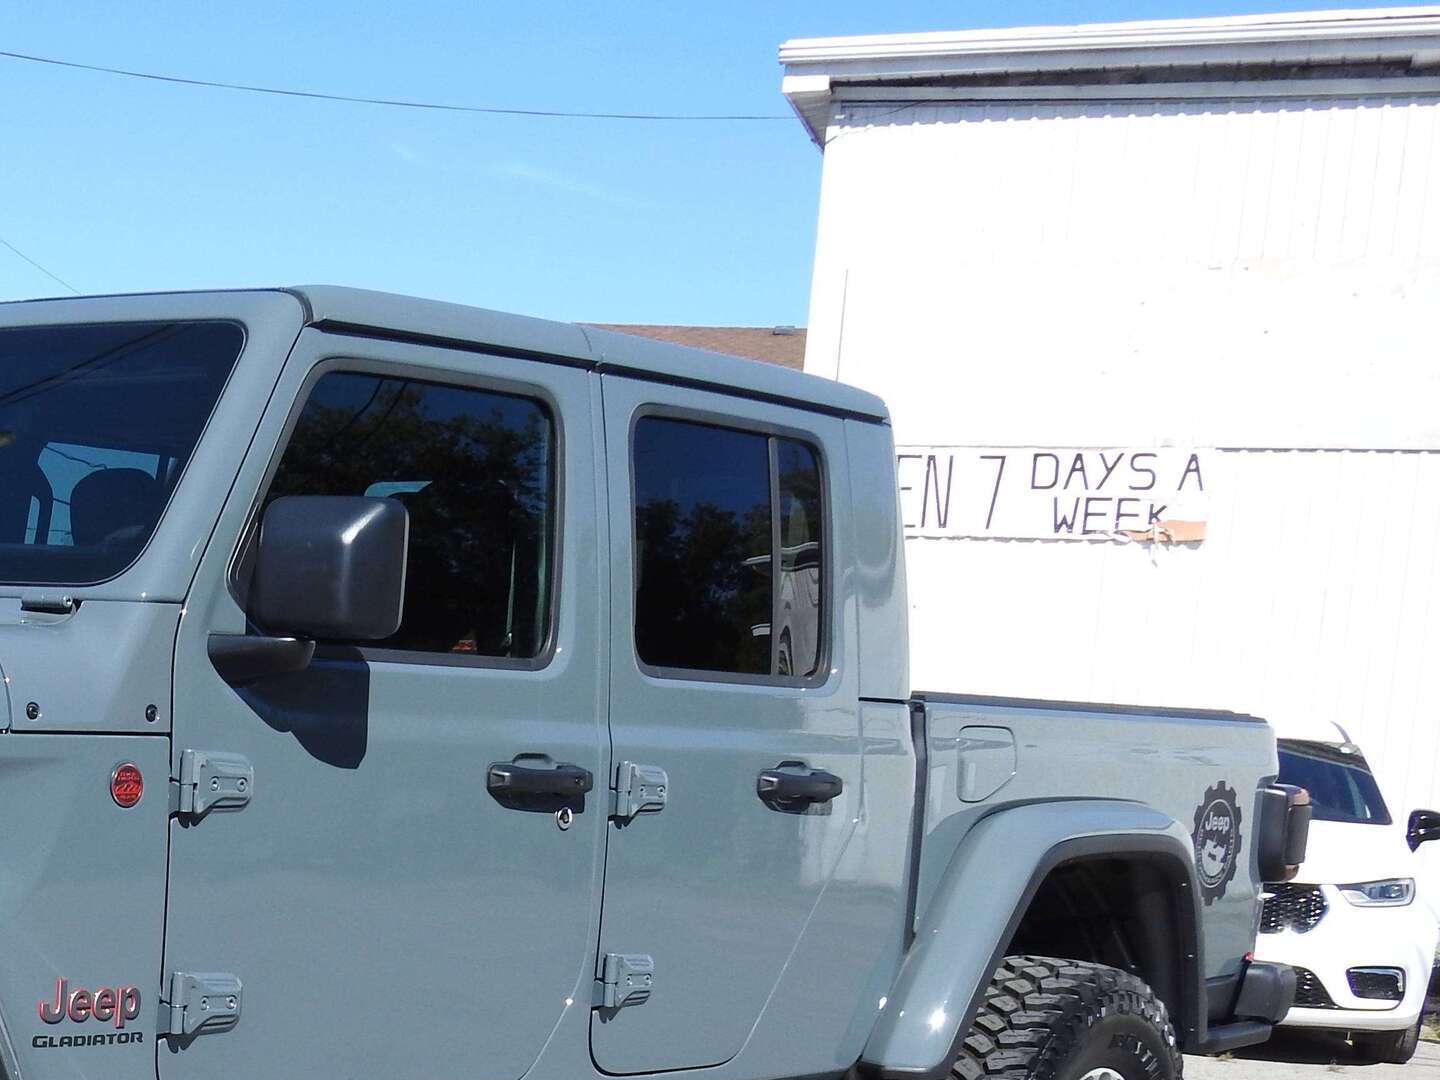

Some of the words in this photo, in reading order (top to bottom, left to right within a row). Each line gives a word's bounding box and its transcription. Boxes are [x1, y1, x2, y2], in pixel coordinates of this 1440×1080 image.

[980, 455, 1007, 529] 7
[1031, 452, 1159, 491] DAYS
[1176, 453, 1204, 491] A
[1053, 496, 1168, 535] WEEK
[1205, 812, 1230, 834] Jeep
[37, 976, 142, 1029] Jeep
[31, 1031, 144, 1048] GLADIATOR
